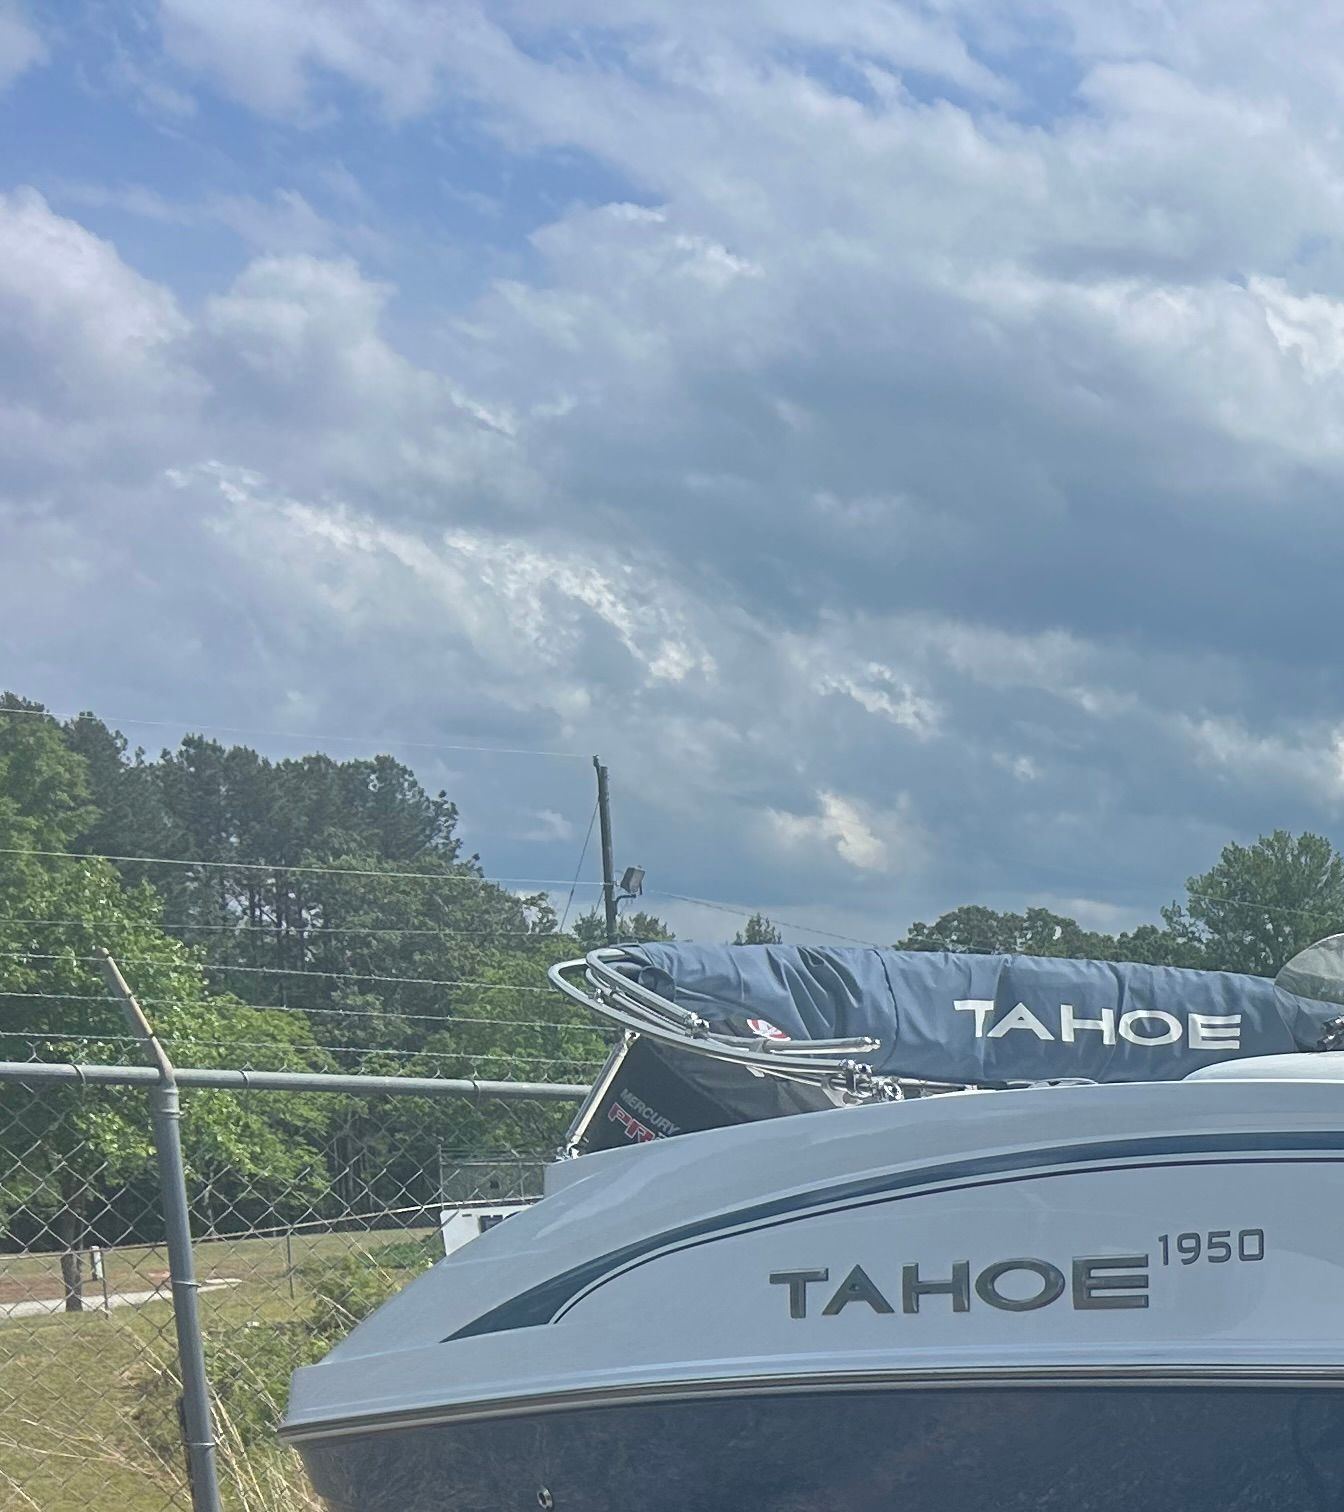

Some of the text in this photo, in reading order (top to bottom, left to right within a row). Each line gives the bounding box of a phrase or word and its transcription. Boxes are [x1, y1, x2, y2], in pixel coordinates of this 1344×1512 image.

[953, 1000, 1242, 1050] TAHOE
[607, 1102, 668, 1143] PR
[620, 1088, 681, 1135] MERCURY
[769, 1228, 1266, 1319] TAHOE 1950
